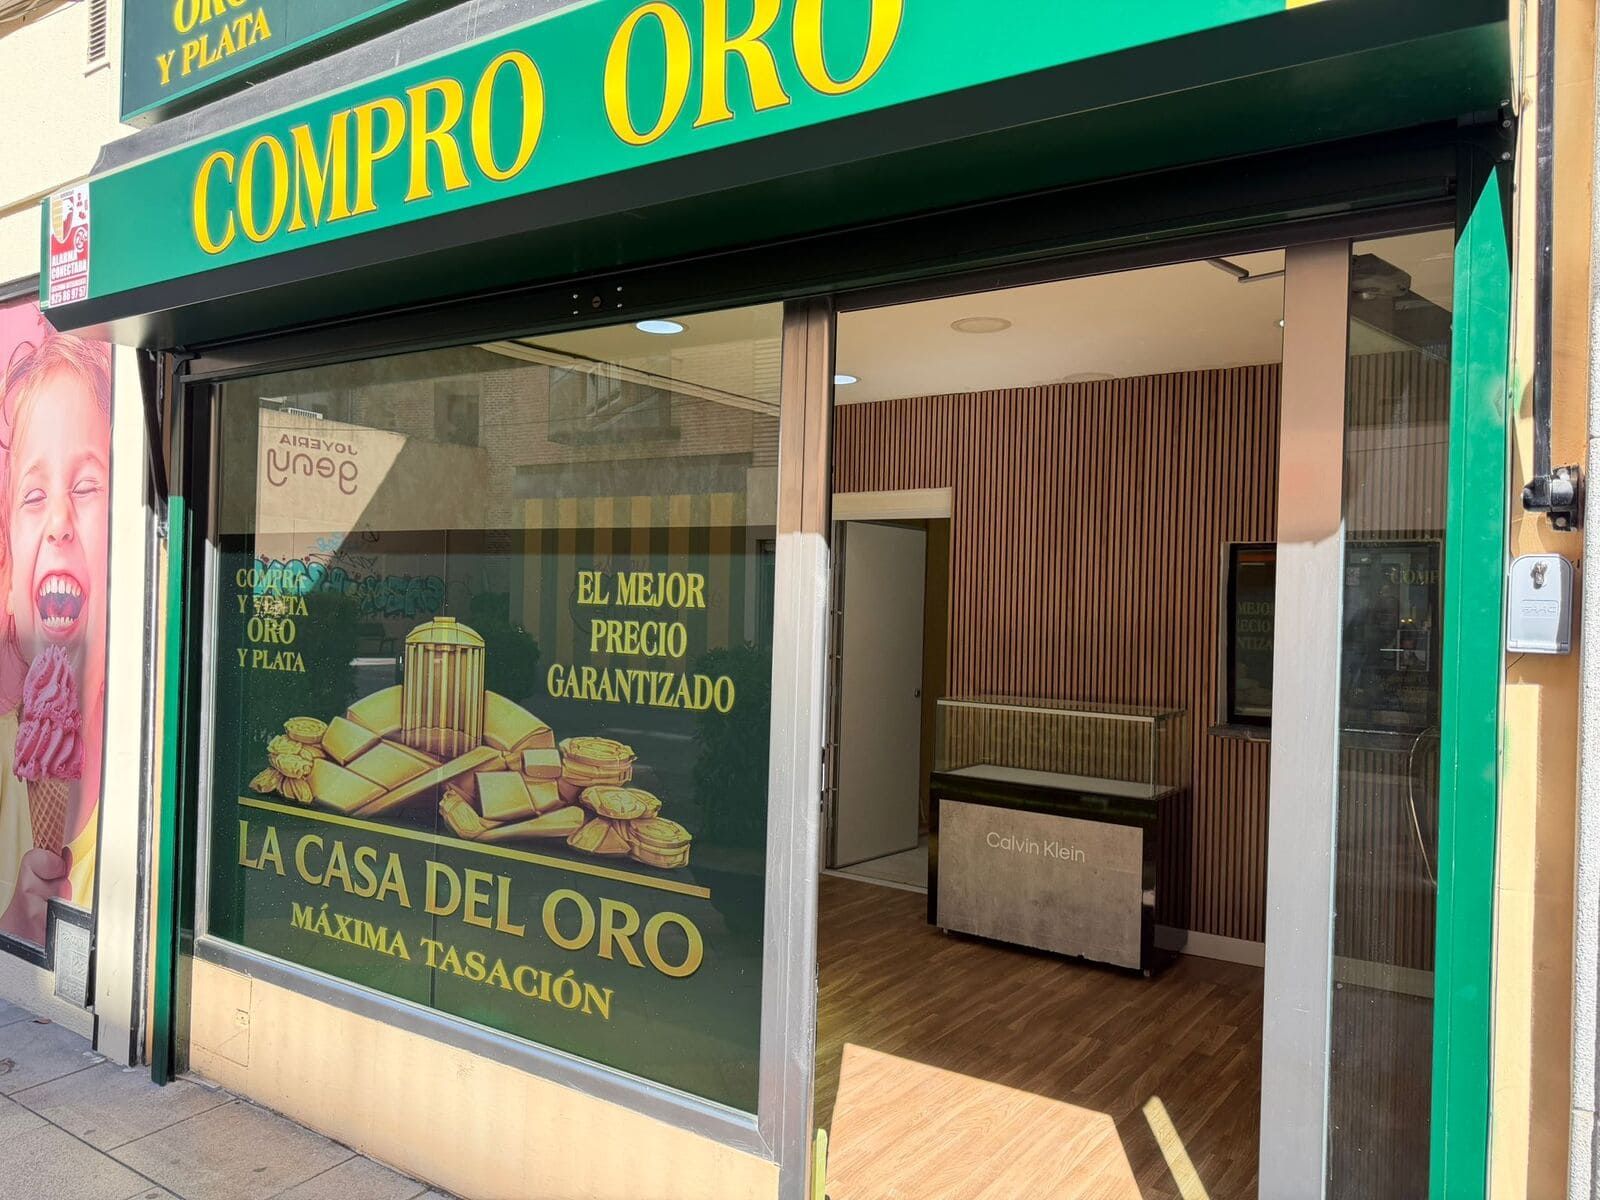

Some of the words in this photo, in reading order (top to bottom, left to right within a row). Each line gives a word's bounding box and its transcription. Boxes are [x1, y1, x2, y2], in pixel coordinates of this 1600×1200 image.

[173, 0, 247, 33] OR
[156, 49, 176, 86] Y
[181, 7, 272, 76] PLATA
[192, 49, 545, 255] COMPRO
[603, 0, 904, 146] ORO
[236, 568, 306, 589] COMPRA
[577, 571, 610, 605] EL
[615, 571, 706, 609] MEJOR
[237, 594, 248, 614] Y
[247, 616, 296, 645] ORO
[590, 619, 688, 658] PRECIO
[237, 648, 248, 668] Y
[252, 649, 306, 673] PLATA
[547, 663, 736, 714] GARANTIZADO
[986, 831, 1040, 856] Calvin
[1043, 840, 1086, 863] Klein
[238, 819, 286, 877] LA
[295, 834, 412, 909] CASA
[424, 859, 526, 938] DEL
[542, 888, 704, 979] ORO
[290, 902, 411, 962] MÁXIMA
[420, 937, 615, 1021] TASACIÓN
